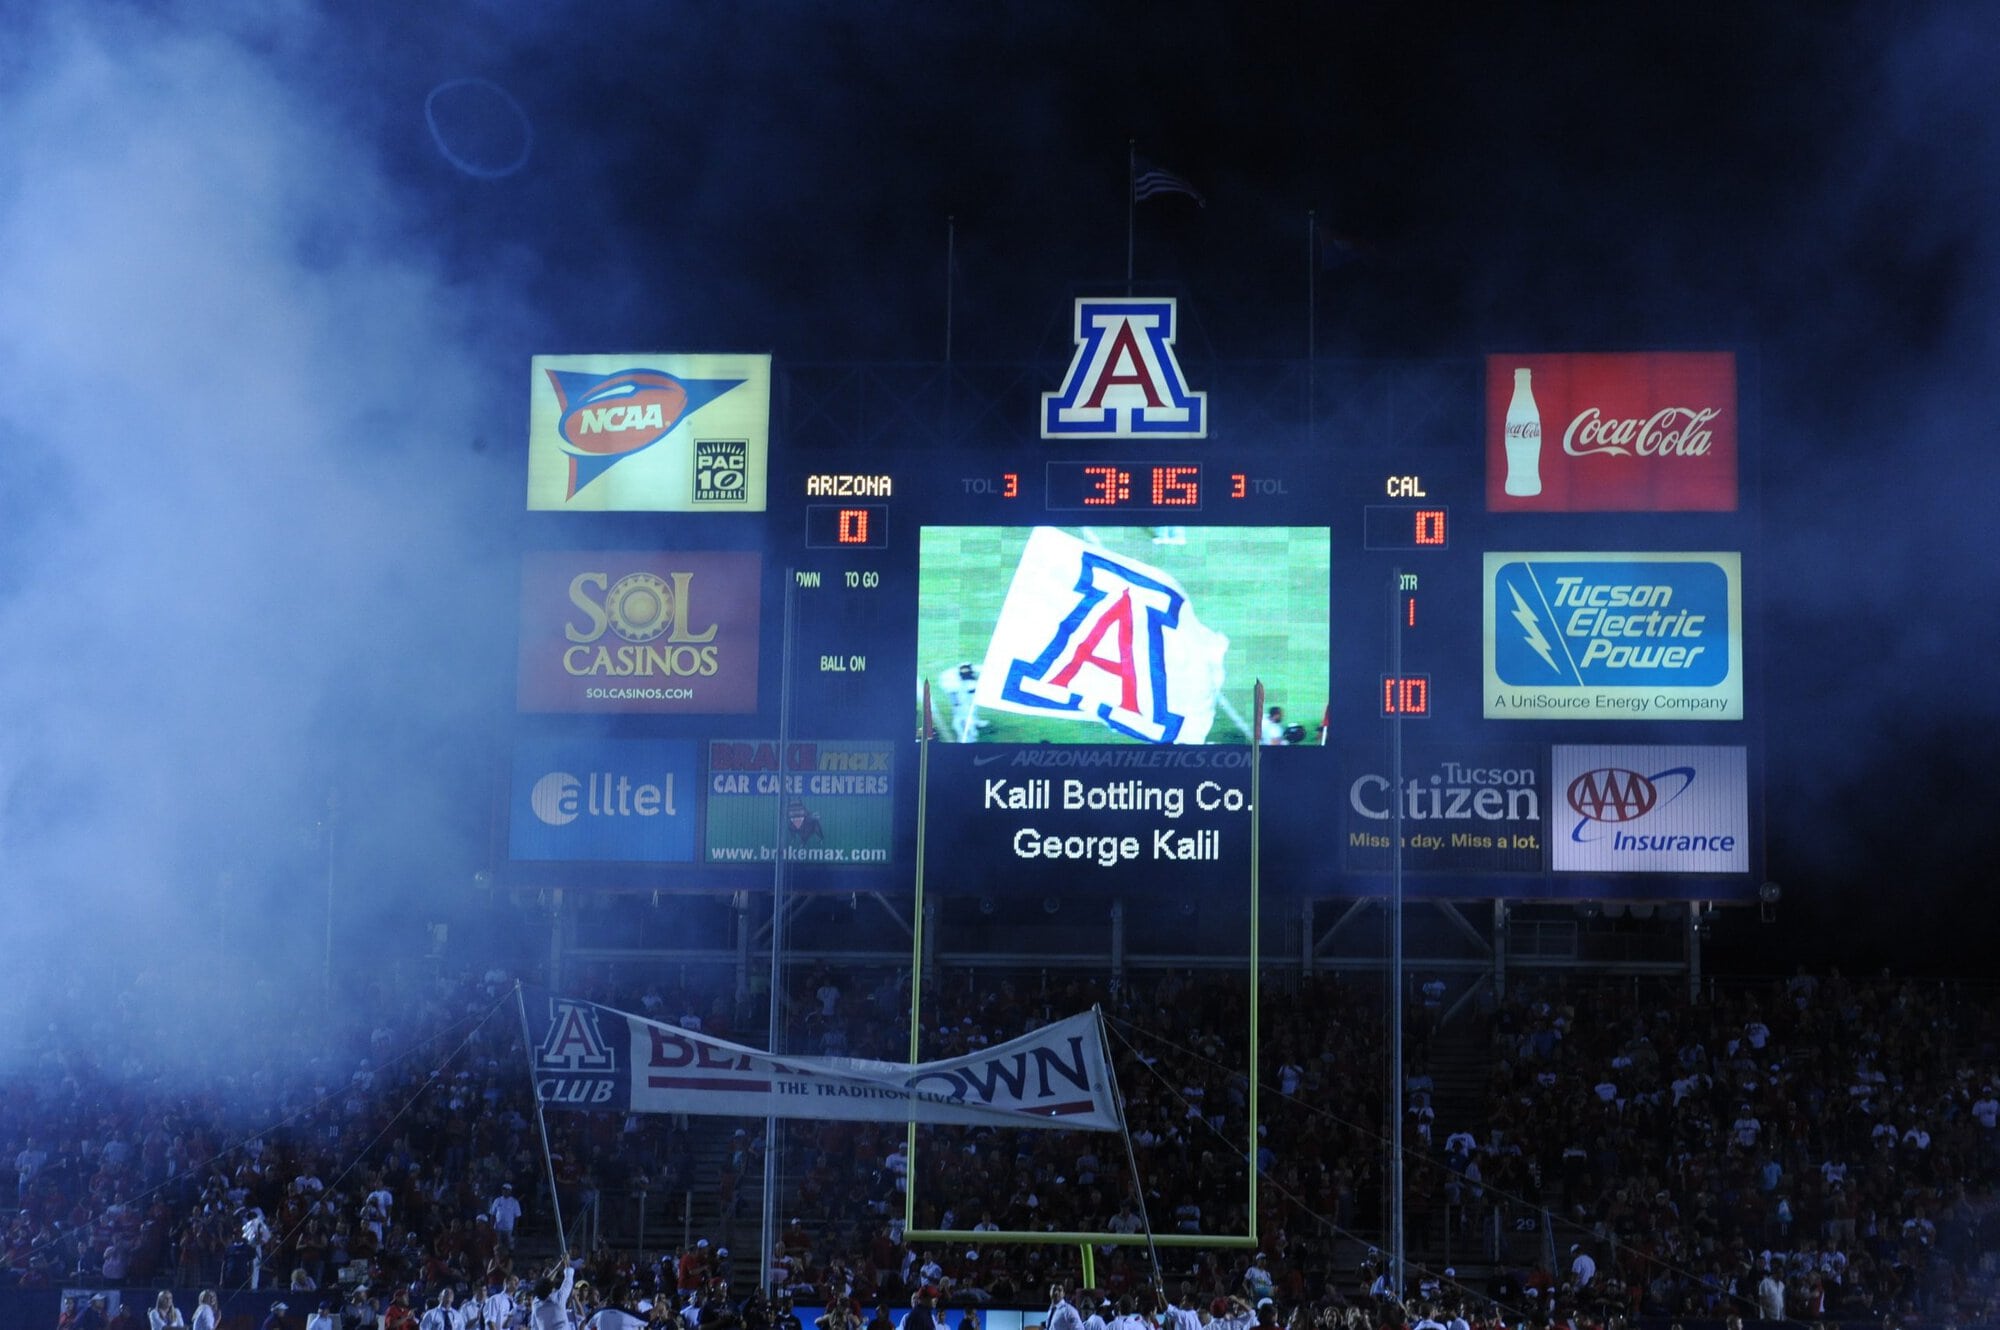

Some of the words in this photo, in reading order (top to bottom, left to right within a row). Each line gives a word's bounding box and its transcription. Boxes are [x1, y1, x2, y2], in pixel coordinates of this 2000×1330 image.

[580, 403, 664, 435] NCAA
[1563, 407, 1721, 457] Coca-Cola
[698, 455, 744, 470] PAC
[698, 470, 744, 490] 10
[807, 475, 892, 497] ARIZONA
[962, 479, 998, 494] TOL
[1003, 474, 1018, 497] 3
[1084, 467, 1197, 505] 3:15
[1231, 474, 1245, 498] 3
[1253, 480, 1288, 495] TOL
[1387, 476, 1426, 497] CAL
[697, 490, 743, 499] FOOTBALL
[839, 510, 868, 543] 0
[1415, 511, 1445, 544] 0
[845, 571, 860, 588] TO
[863, 571, 879, 588] GO
[1554, 577, 1673, 607] Tucson
[565, 572, 719, 643] SOL
[1566, 607, 1706, 638] Electric
[563, 646, 719, 677] CASINOS
[820, 655, 846, 671] BALL
[850, 655, 866, 671] ON
[1580, 638, 1706, 669] Power
[586, 687, 693, 700] SOLCASINOS.COM
[1495, 695, 1506, 709] A
[1511, 694, 1590, 709] UniSource
[1596, 695, 1649, 712] Energy
[1654, 695, 1728, 712] Company
[713, 774, 750, 794] CAR
[810, 774, 888, 794] CENTERS
[1441, 762, 1536, 785] Tucson
[555, 772, 676, 818] alltel
[985, 779, 1050, 809] Kalil
[1063, 779, 1185, 818] Bottling
[1196, 781, 1254, 810] Co.
[1576, 768, 1648, 821] AAA
[1013, 828, 1140, 866] George
[1153, 829, 1220, 860] Kalil
[1350, 833, 1390, 848] Miss
[1411, 834, 1445, 850] day.
[1452, 833, 1492, 848] Miss
[1497, 838, 1507, 849] a
[1512, 834, 1540, 849] lot.
[1613, 831, 1735, 852] Insurance
[537, 1079, 615, 1103] CLUB
[778, 1081, 808, 1097] THE
[816, 1083, 911, 1101] TRADITION
[1516, 1218, 1535, 1231] 29
